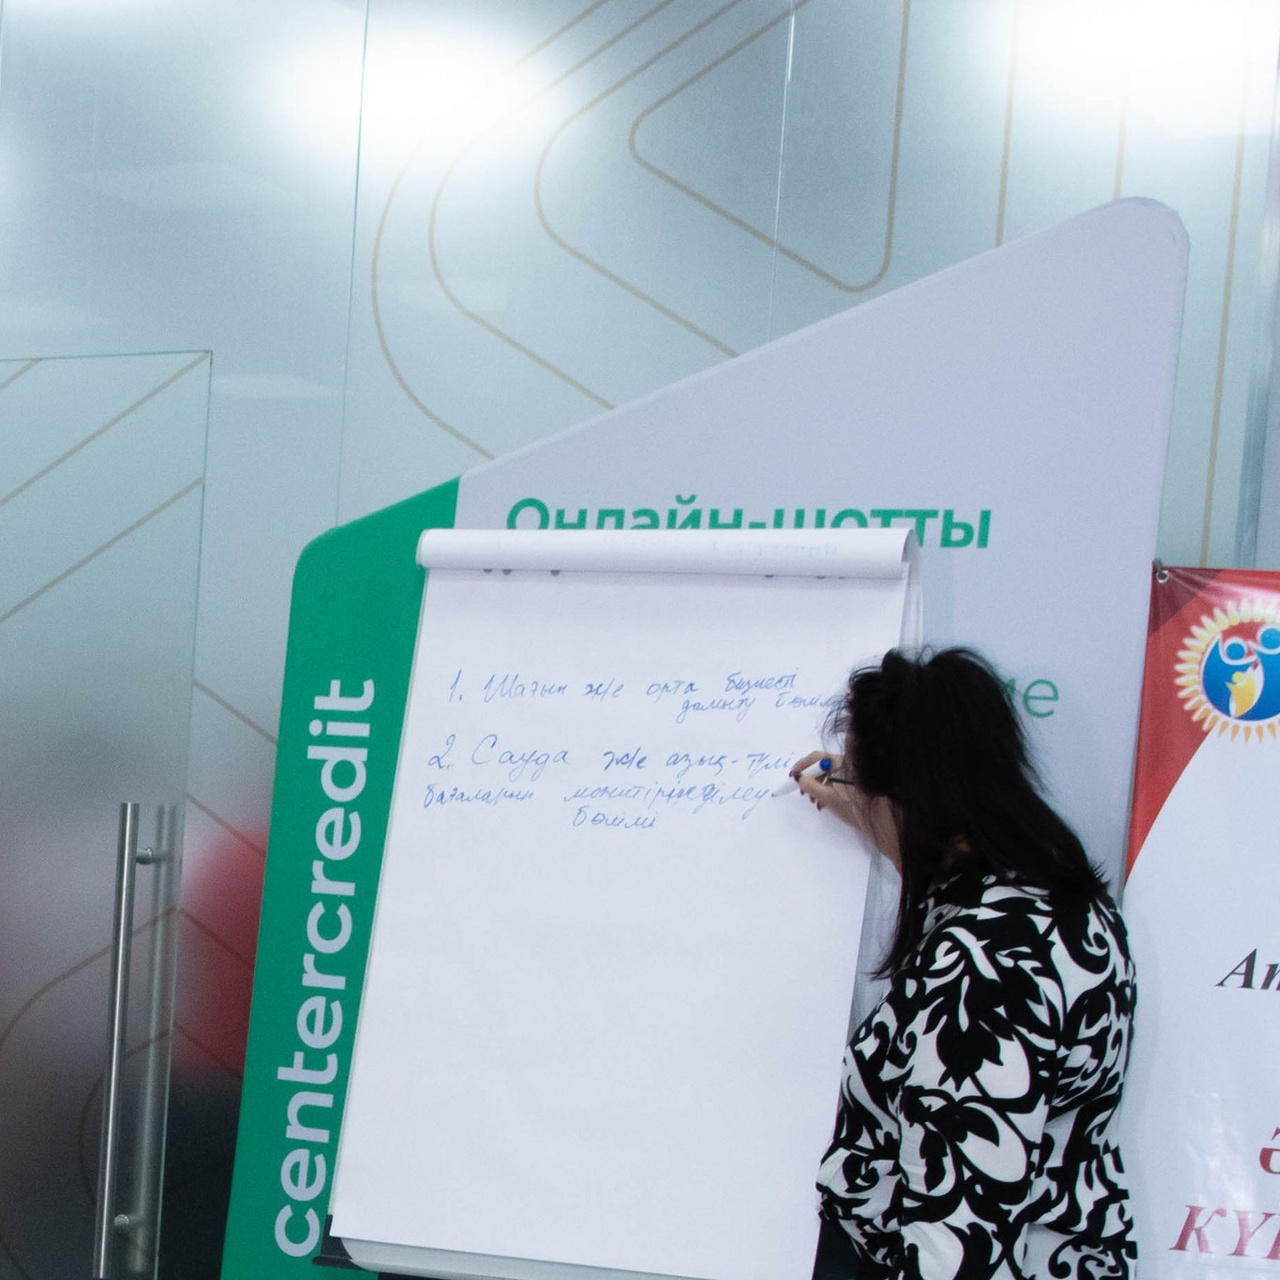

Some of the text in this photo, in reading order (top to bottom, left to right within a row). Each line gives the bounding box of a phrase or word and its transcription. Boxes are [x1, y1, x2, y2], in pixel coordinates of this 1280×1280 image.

[449, 669, 463, 702] 1.
[428, 733, 454, 769] 2.
[472, 733, 570, 783] Сауда
[274, 678, 375, 1258] centercredit
